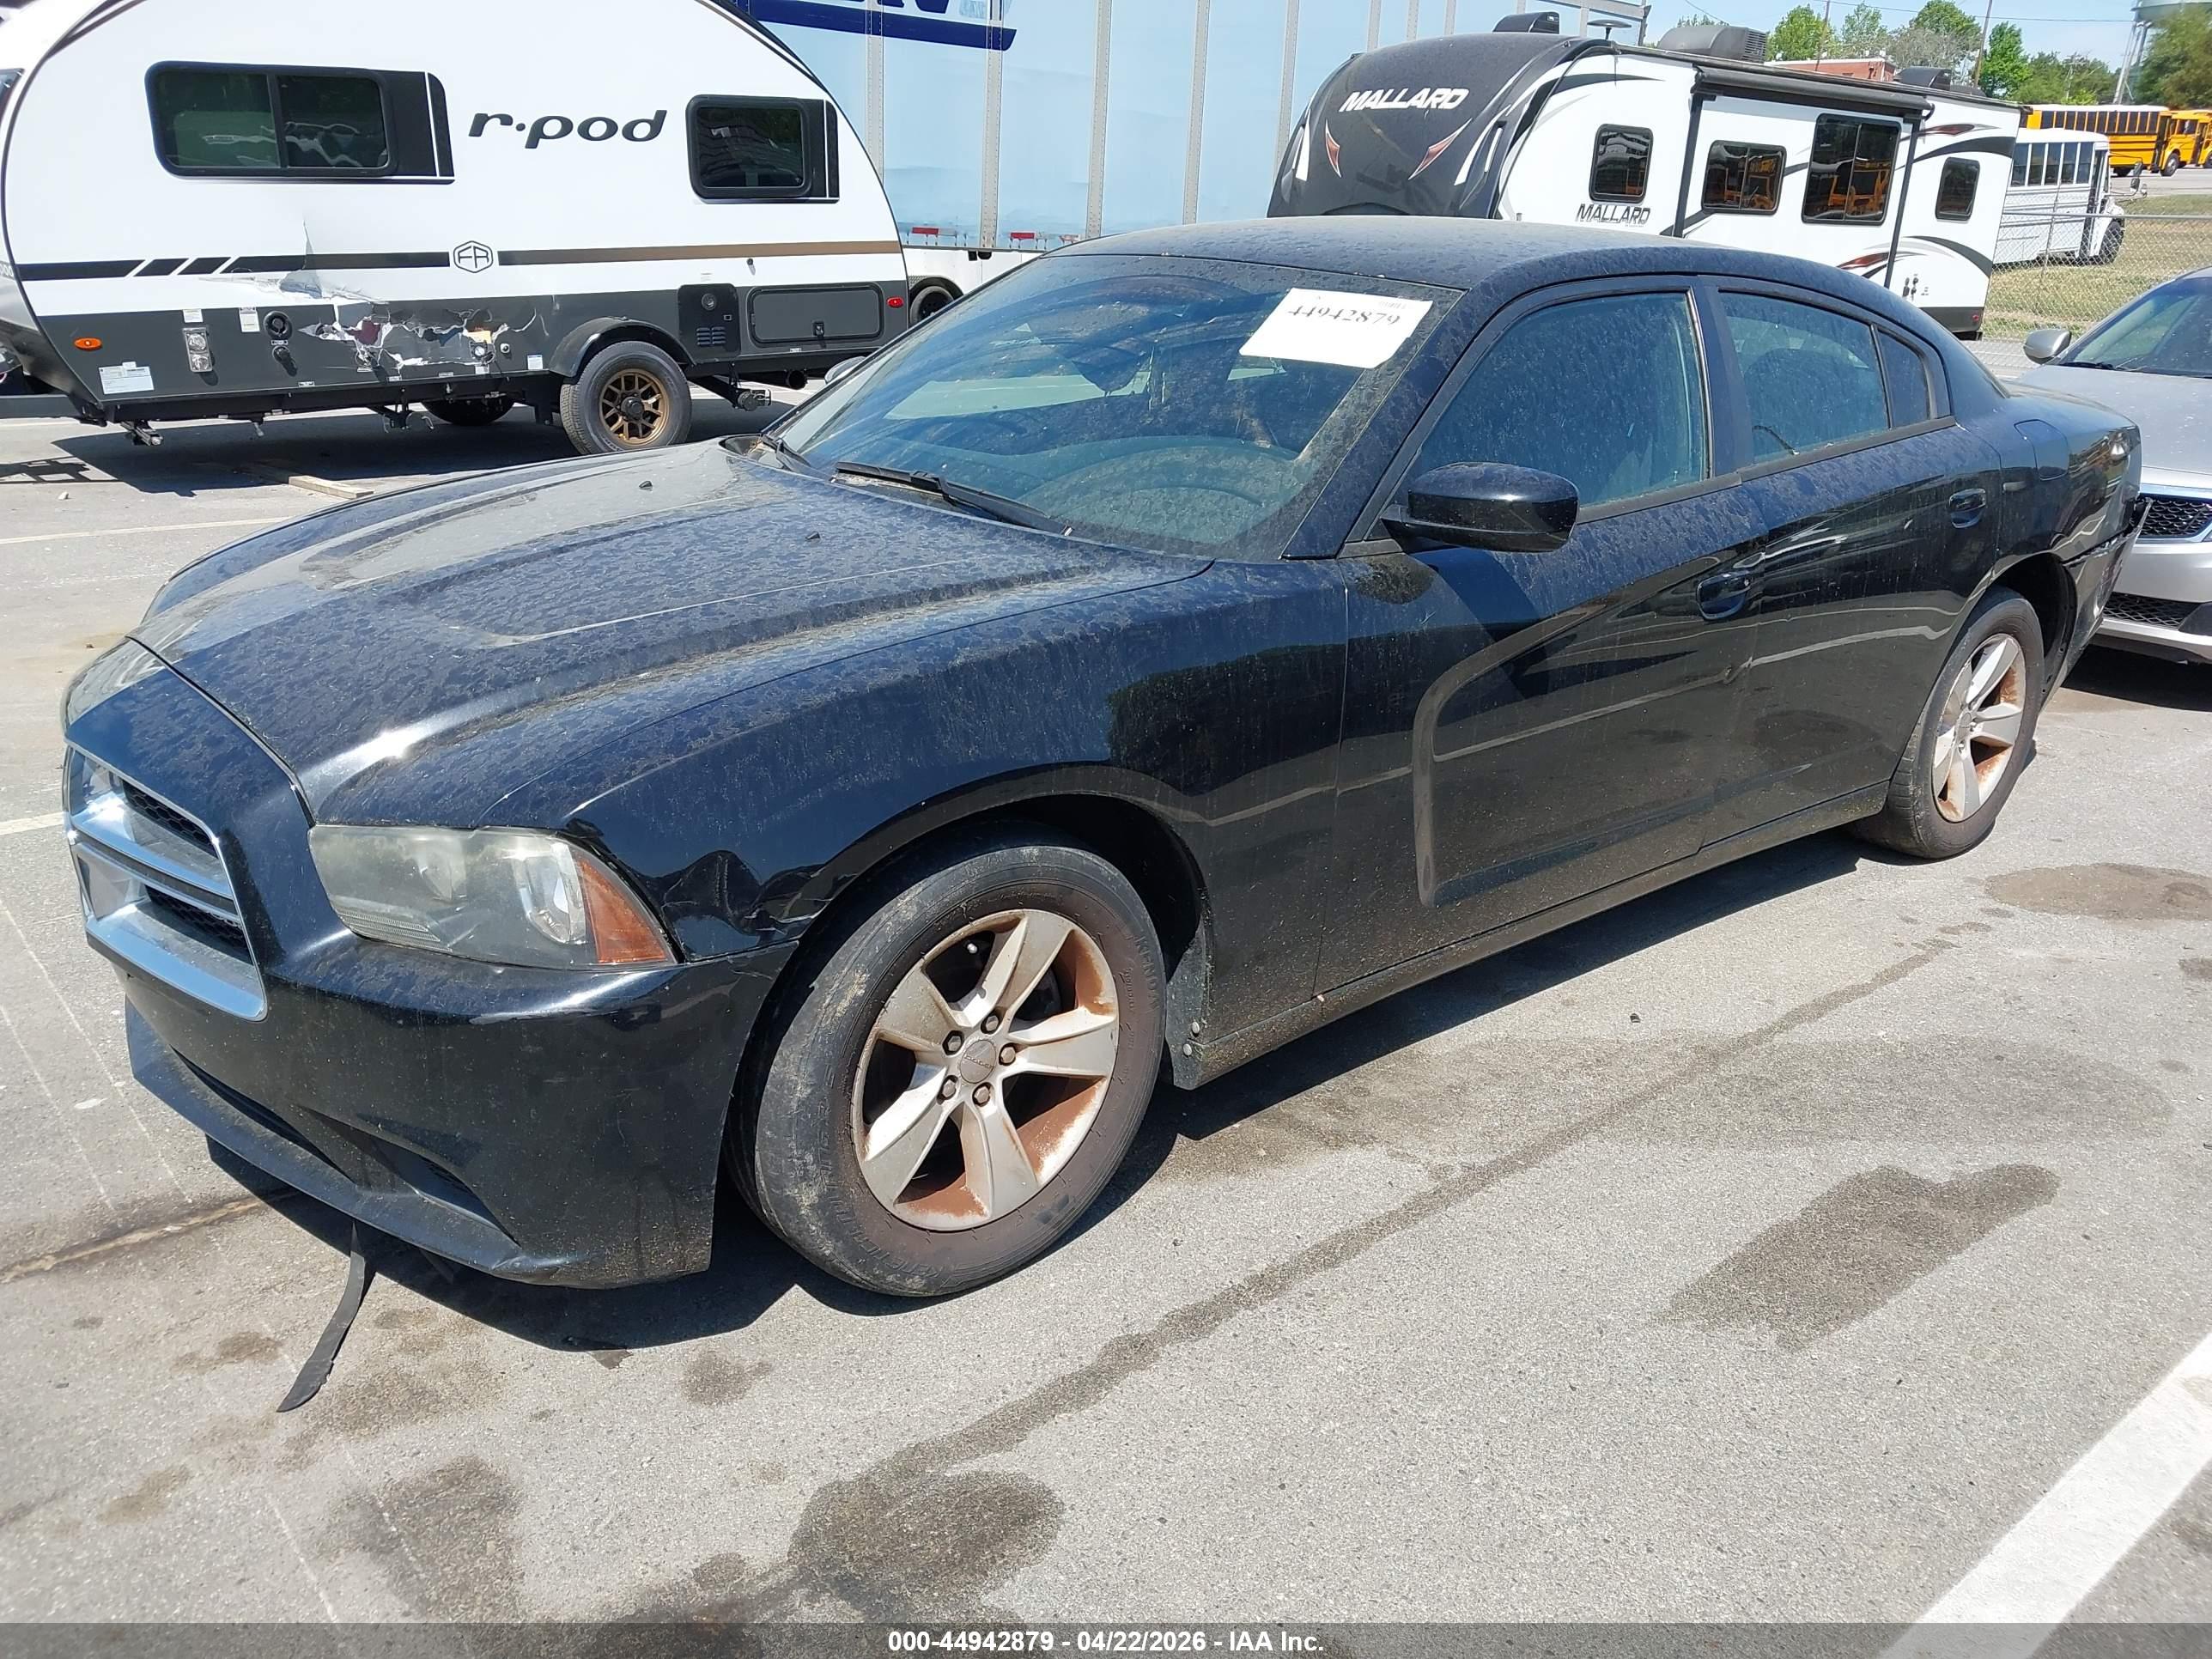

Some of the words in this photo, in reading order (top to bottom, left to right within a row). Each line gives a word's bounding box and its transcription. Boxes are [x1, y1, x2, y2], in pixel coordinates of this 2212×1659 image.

[1339, 88, 1469, 112] MALLARD
[1575, 204, 1650, 224] MALLARD
[1288, 305, 1401, 325] 44942879
